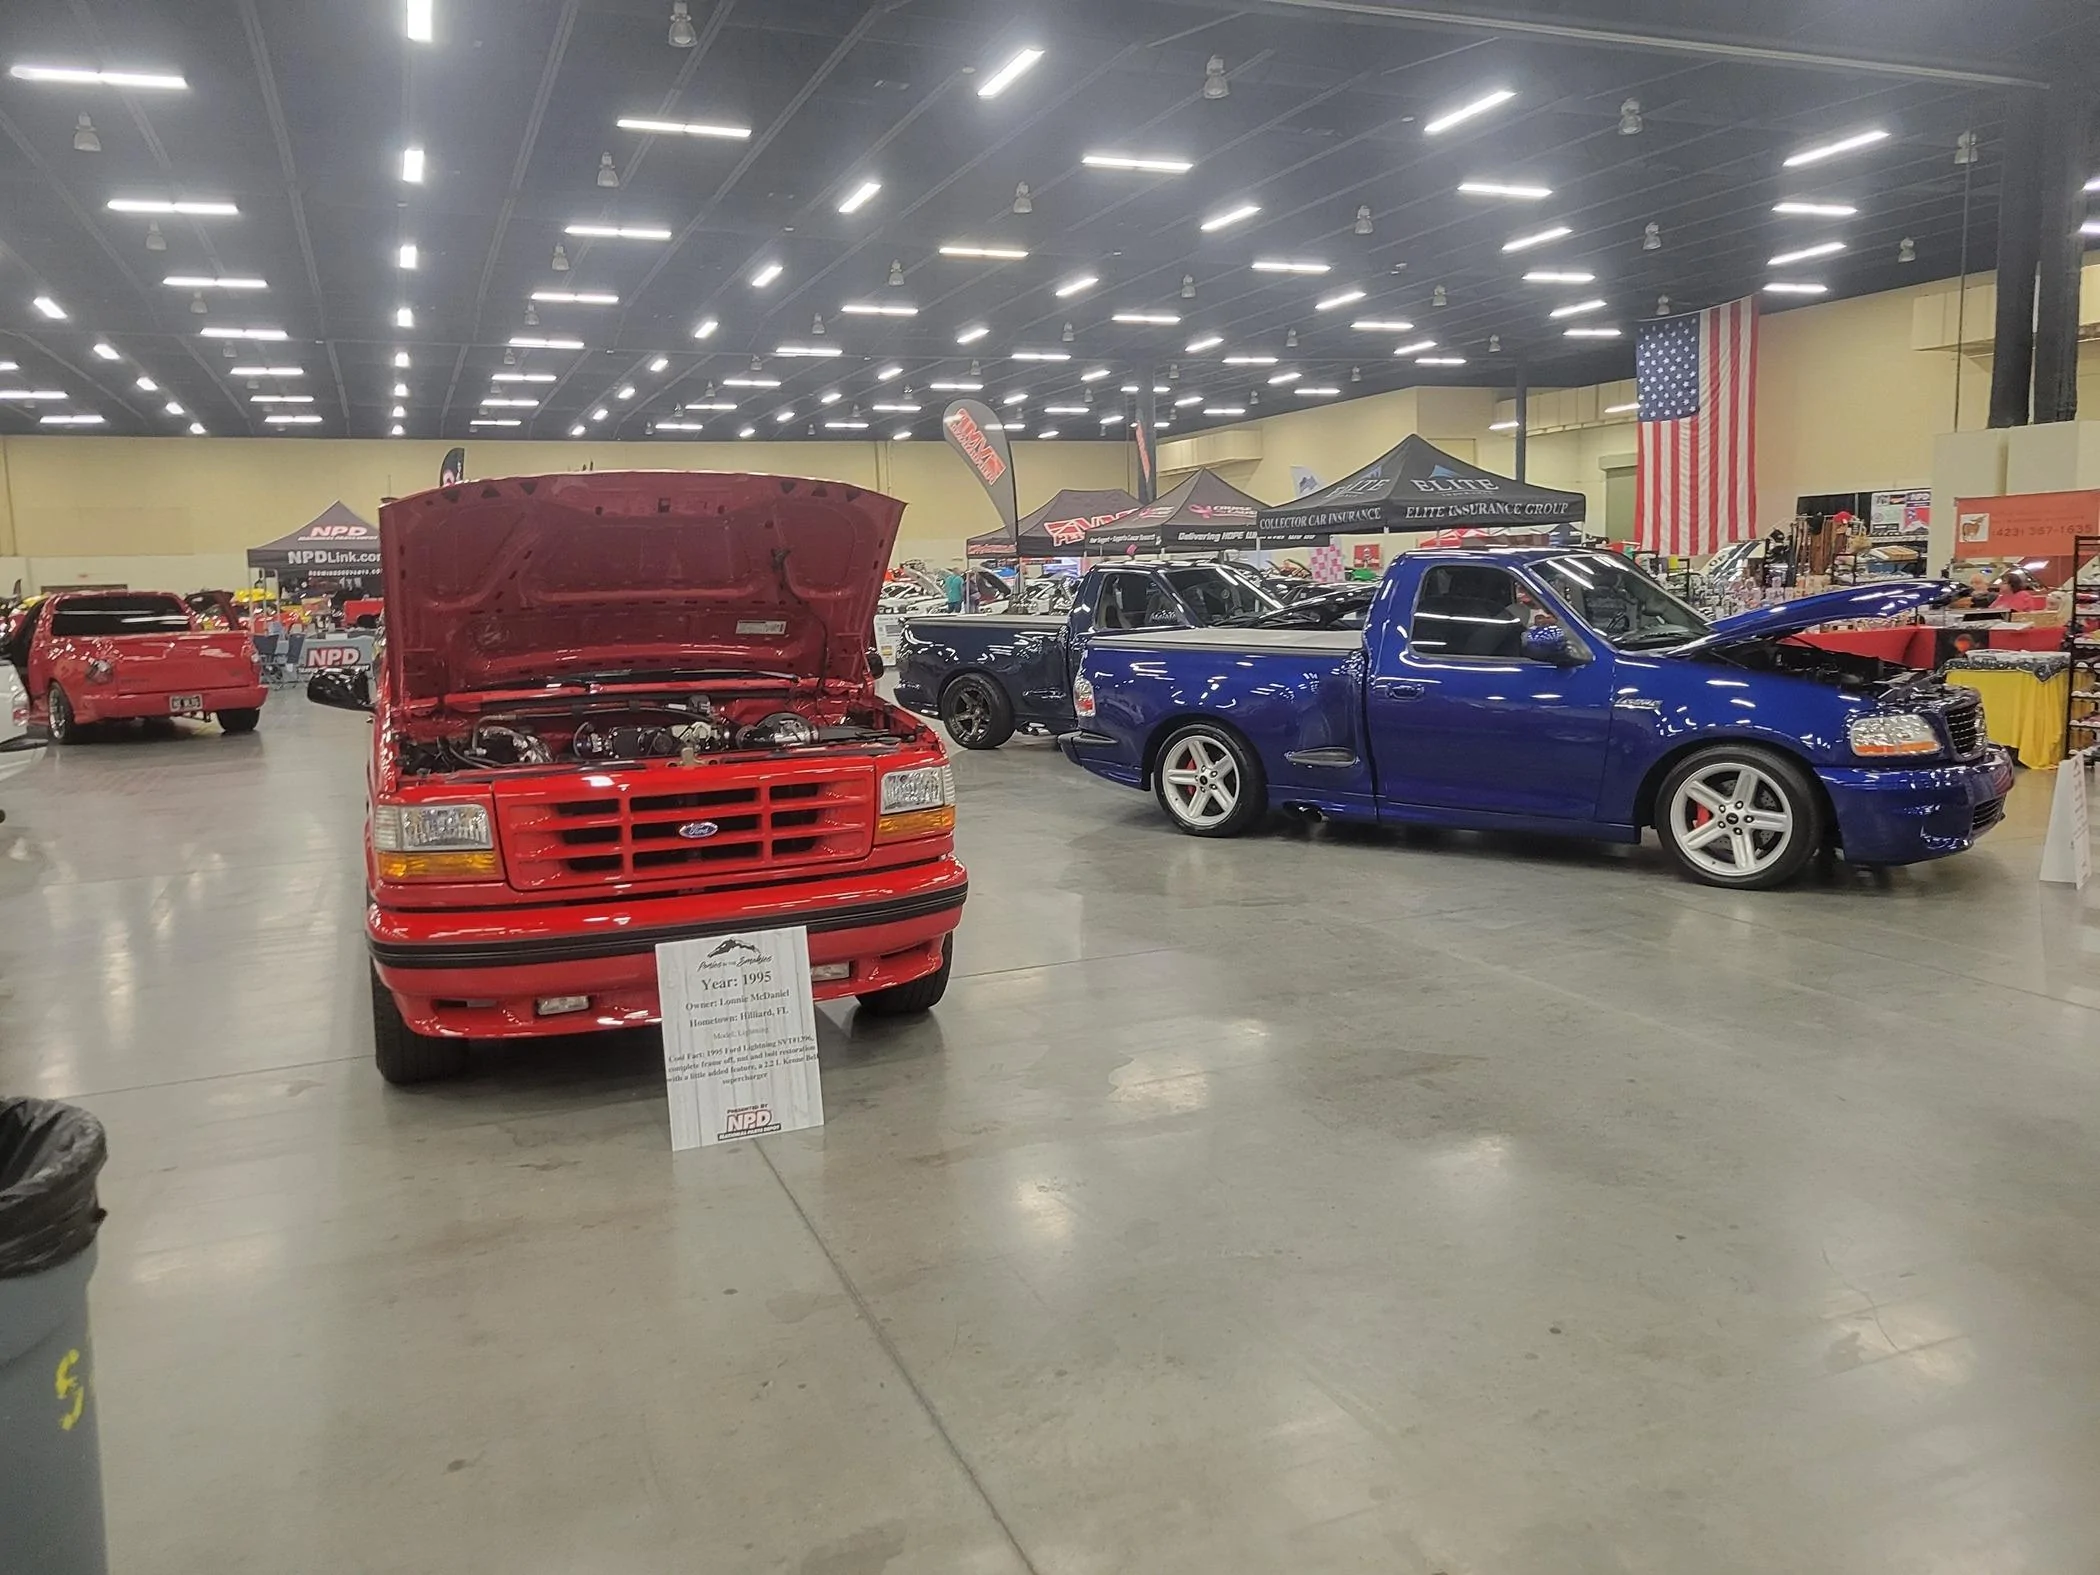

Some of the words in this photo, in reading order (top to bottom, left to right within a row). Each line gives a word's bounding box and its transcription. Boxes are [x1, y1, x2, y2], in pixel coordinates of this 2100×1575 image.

[1410, 478, 1499, 492] ELITE
[1260, 517, 1307, 530] COLLECTOR
[1308, 514, 1327, 526] CAR
[1328, 507, 1381, 523] INSURANCE
[1405, 506, 1445, 519] ELITE
[1448, 502, 1522, 516] INSURANCE
[1524, 502, 1569, 515] GROUP
[310, 525, 368, 537] NPD
[1178, 532, 1221, 542] Delivering
[1221, 531, 1245, 540] HOPE
[307, 646, 361, 668] NPD
[701, 978, 738, 991] Year:
[742, 971, 772, 985] 1995
[685, 1000, 717, 1011] Owner:
[720, 996, 749, 1006] Lonnie
[750, 989, 790, 1001] McDaniel
[689, 1016, 738, 1028] Hometown:
[740, 1009, 775, 1021] Hilliard,
[776, 1006, 789, 1015] FL
[707, 1048, 723, 1057] 1995
[743, 1041, 777, 1051] Lightning
[750, 1052, 763, 1060] and
[708, 1068, 729, 1077] added
[722, 1072, 769, 1084] supercharger
[726, 1109, 772, 1133] NPD
